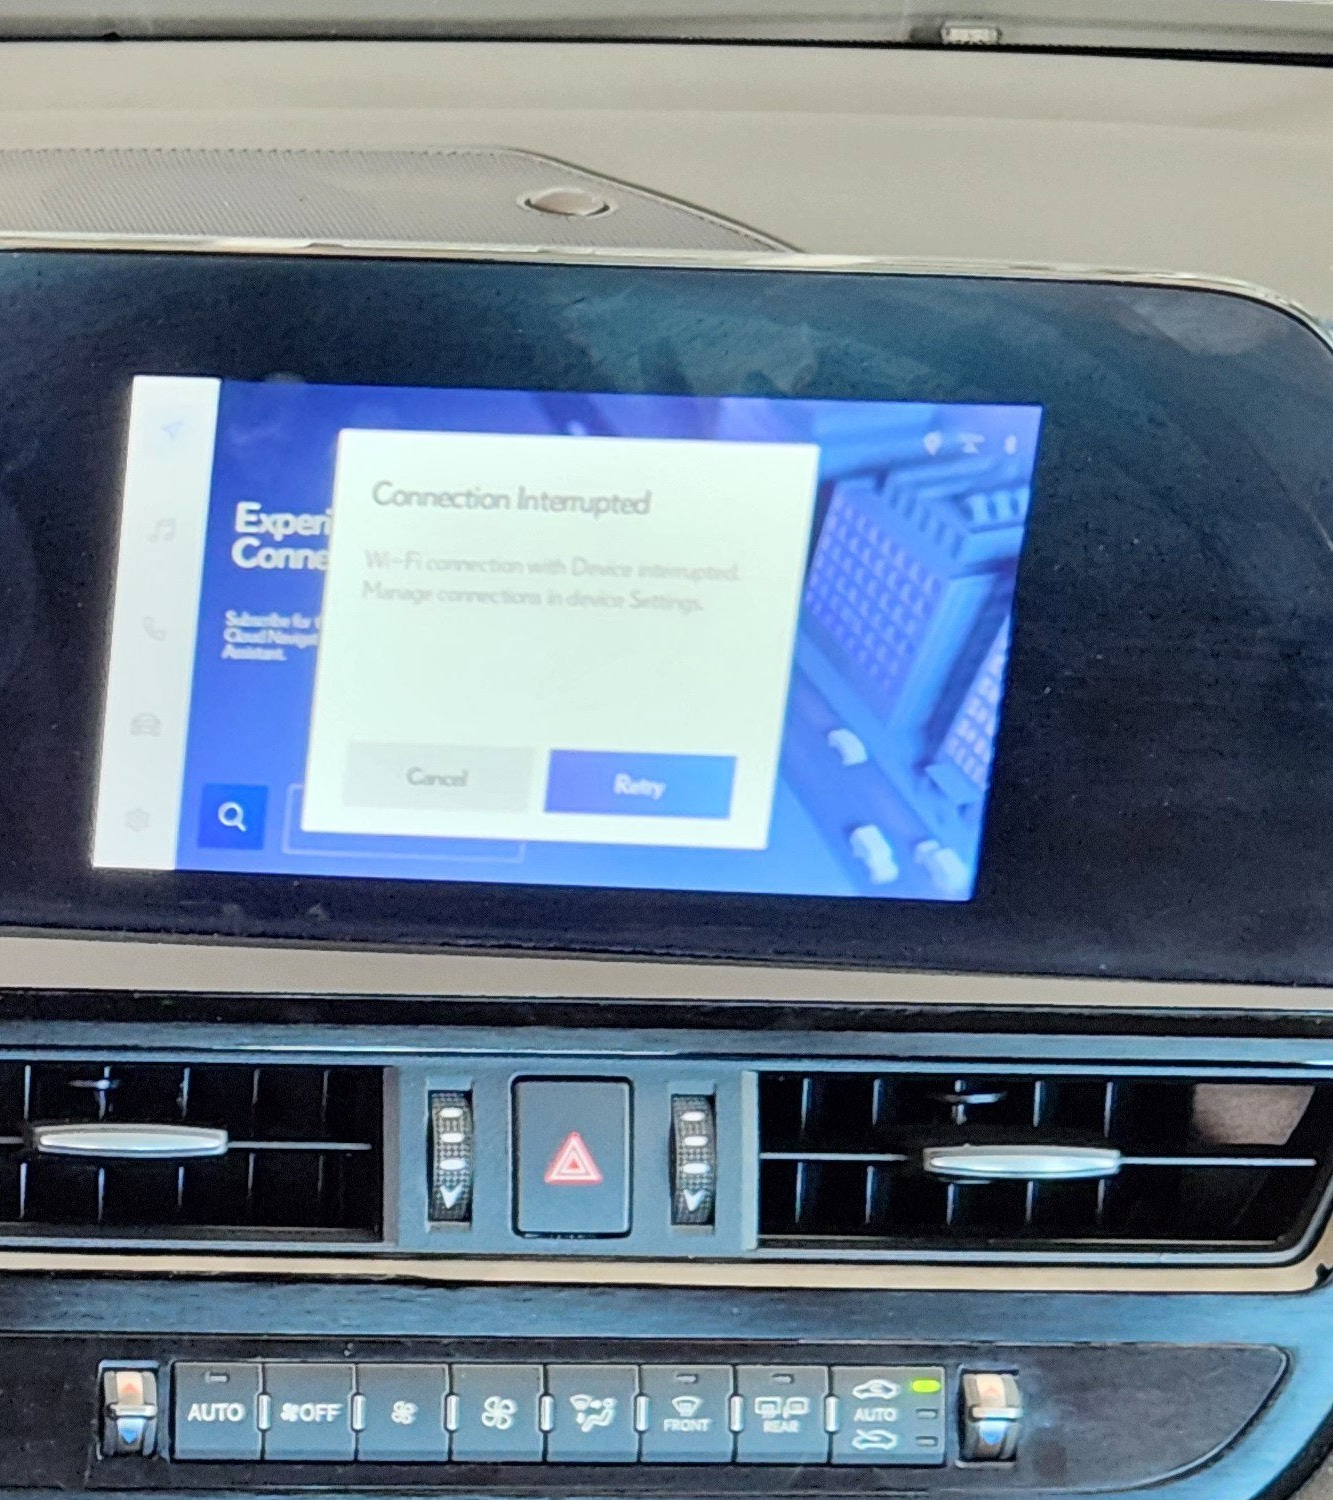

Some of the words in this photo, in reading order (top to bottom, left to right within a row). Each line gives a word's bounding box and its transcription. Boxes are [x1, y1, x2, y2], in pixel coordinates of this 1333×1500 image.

[372, 480, 510, 510] Connection
[518, 486, 652, 518] Interrupted
[406, 766, 469, 789] Cancel
[613, 773, 668, 801] Retry
[187, 1402, 245, 1423] AUTO
[300, 1402, 343, 1423] OFF
[853, 1407, 898, 1423] AUTO
[663, 1418, 711, 1433] FRONT
[763, 1419, 800, 1434] REAR
